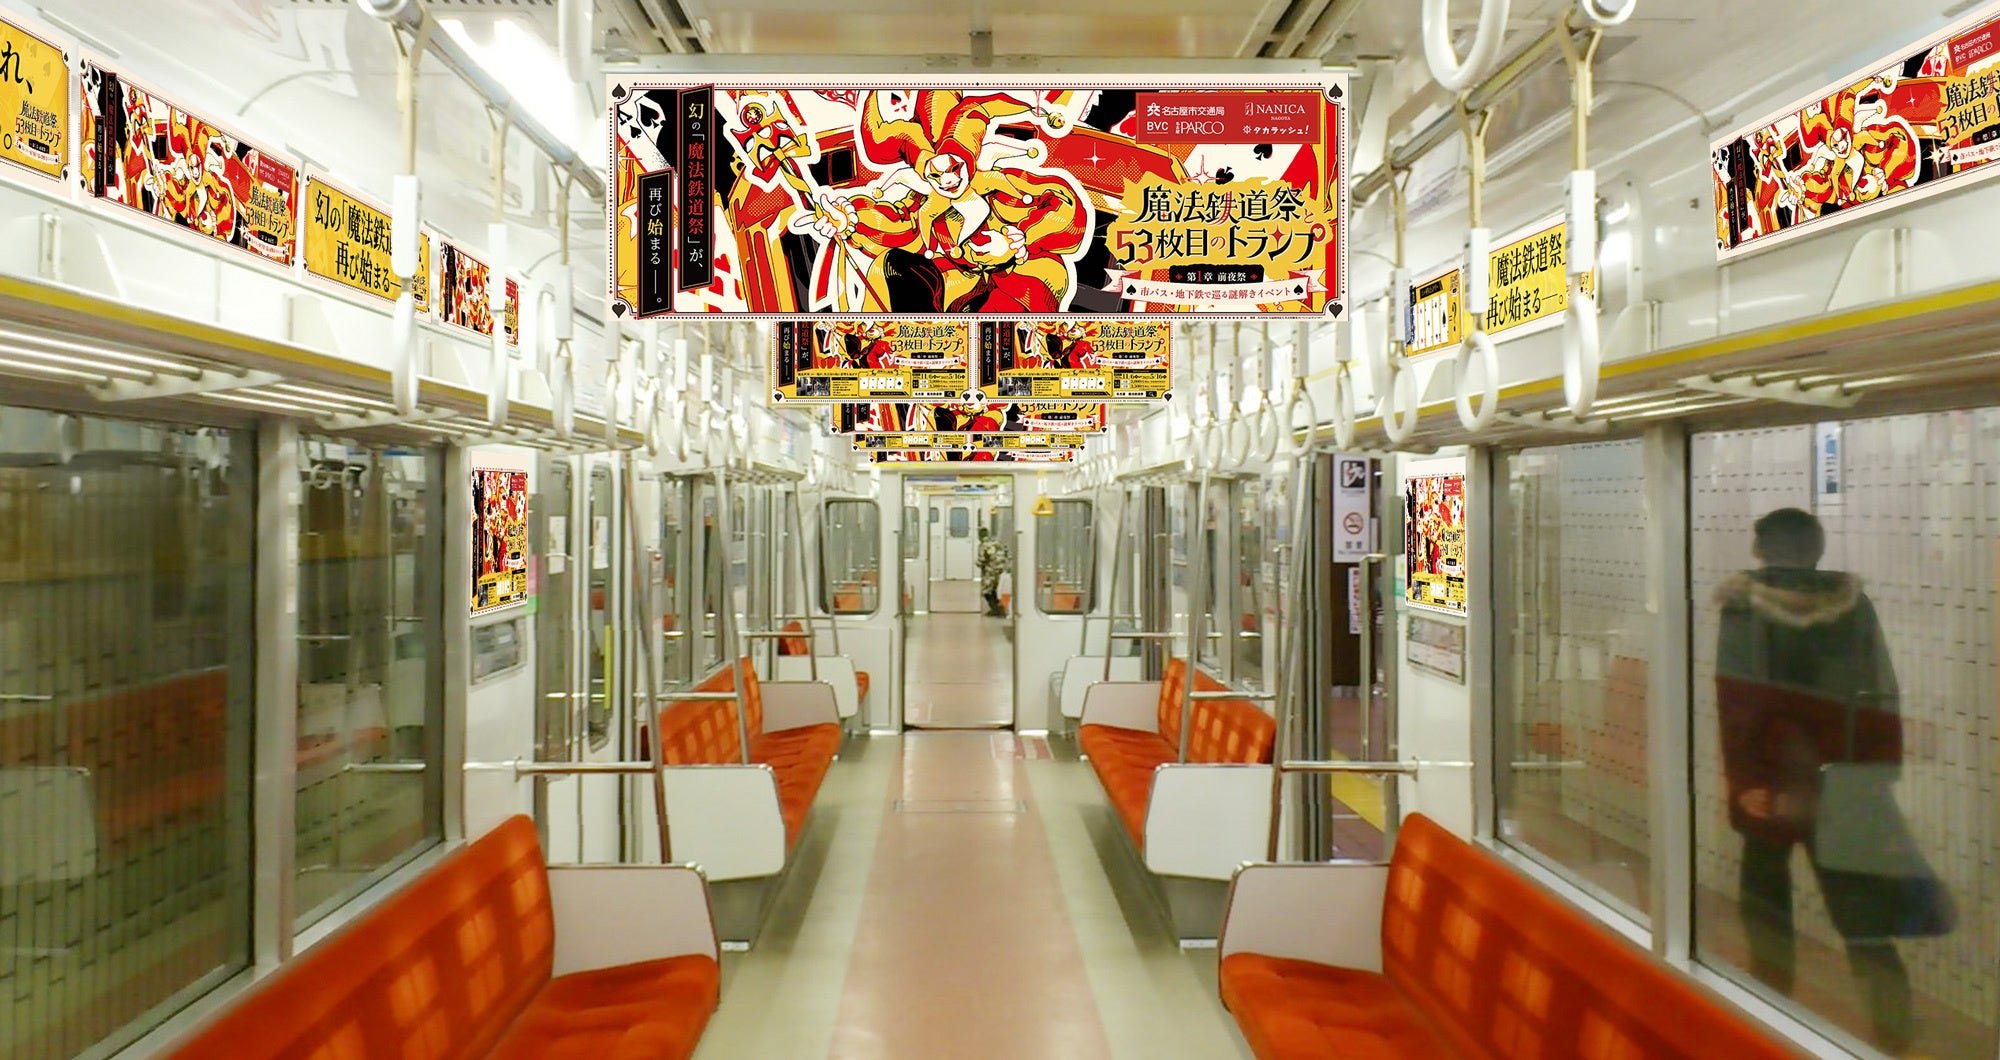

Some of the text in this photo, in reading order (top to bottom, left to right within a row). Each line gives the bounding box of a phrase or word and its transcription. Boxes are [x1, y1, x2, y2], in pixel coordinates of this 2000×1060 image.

[1944, 70, 2000, 113] 魔法鉄
[1161, 106, 1225, 116] 名古屋市交通局
[1256, 104, 1306, 114] NANICA
[1147, 121, 1169, 131] BVC
[1181, 121, 1225, 135] PARCO
[687, 102, 705, 268] 幻の「魔法鉄道祭」が、
[1133, 184, 1314, 226] 魔法鉄道祭と
[1116, 223, 1326, 266] 53枚目のトランプ
[1186, 271, 1247, 282] 第1章 前夜祭
